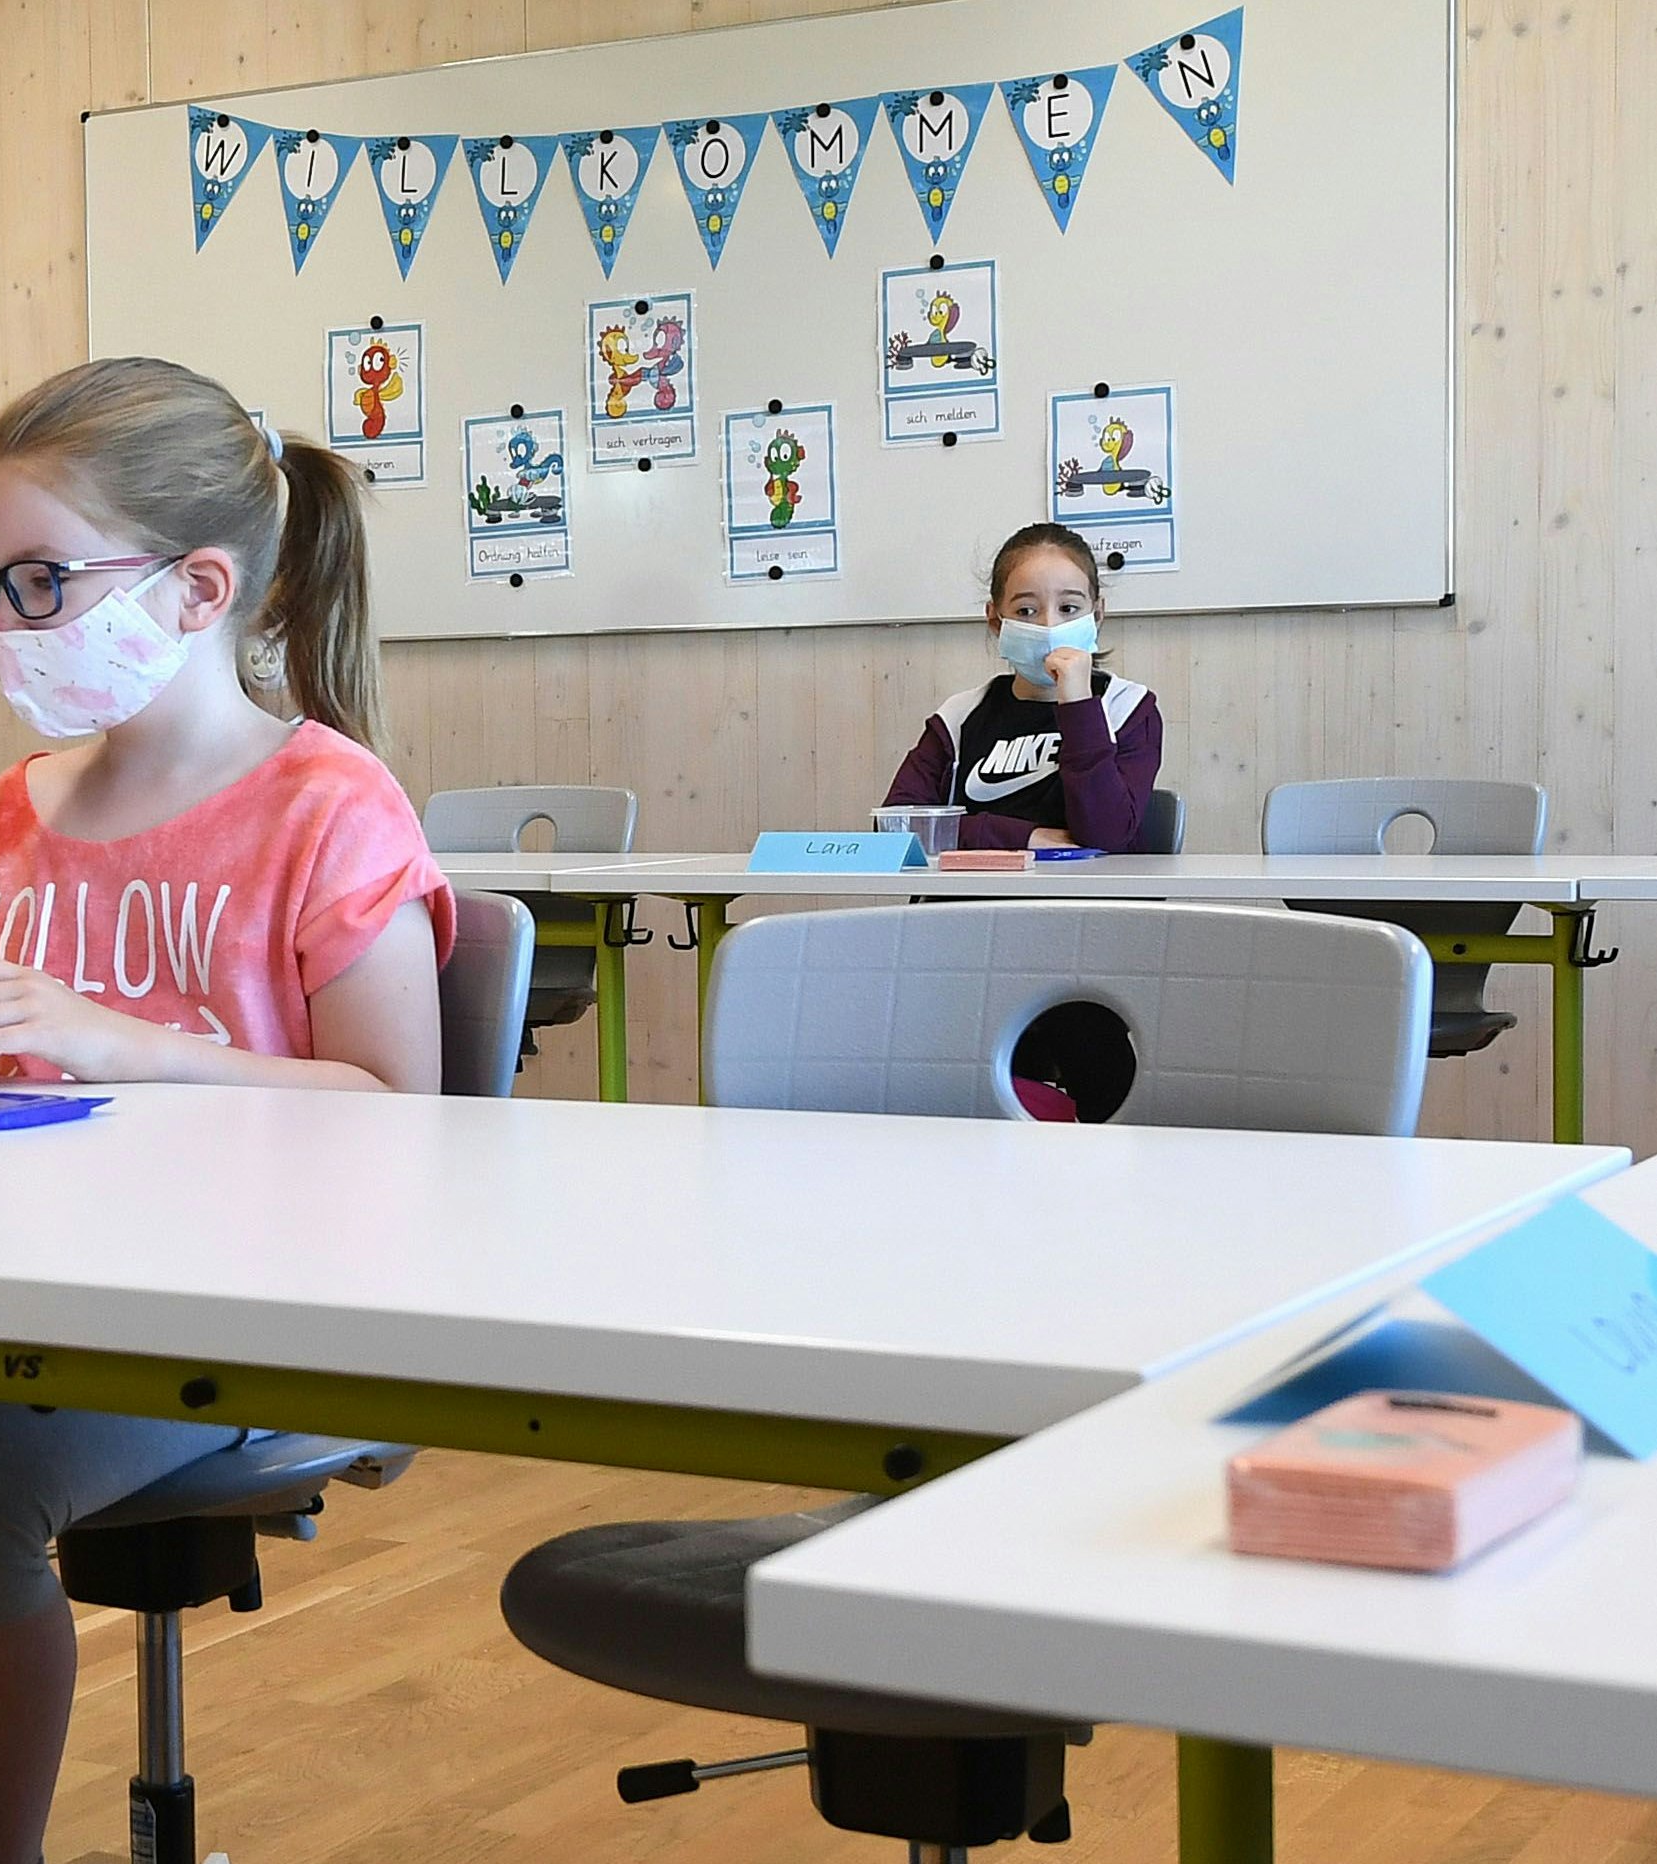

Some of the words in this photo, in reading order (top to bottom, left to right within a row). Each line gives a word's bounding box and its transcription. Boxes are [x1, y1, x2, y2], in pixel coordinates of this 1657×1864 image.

[202, 49, 1215, 196] WILLKOMMEN
[935, 406, 977, 422] melden
[632, 433, 682, 448] vertragen
[980, 732, 1063, 774] NIKE
[805, 841, 860, 855] Lara
[4, 1354, 43, 1380] VS
